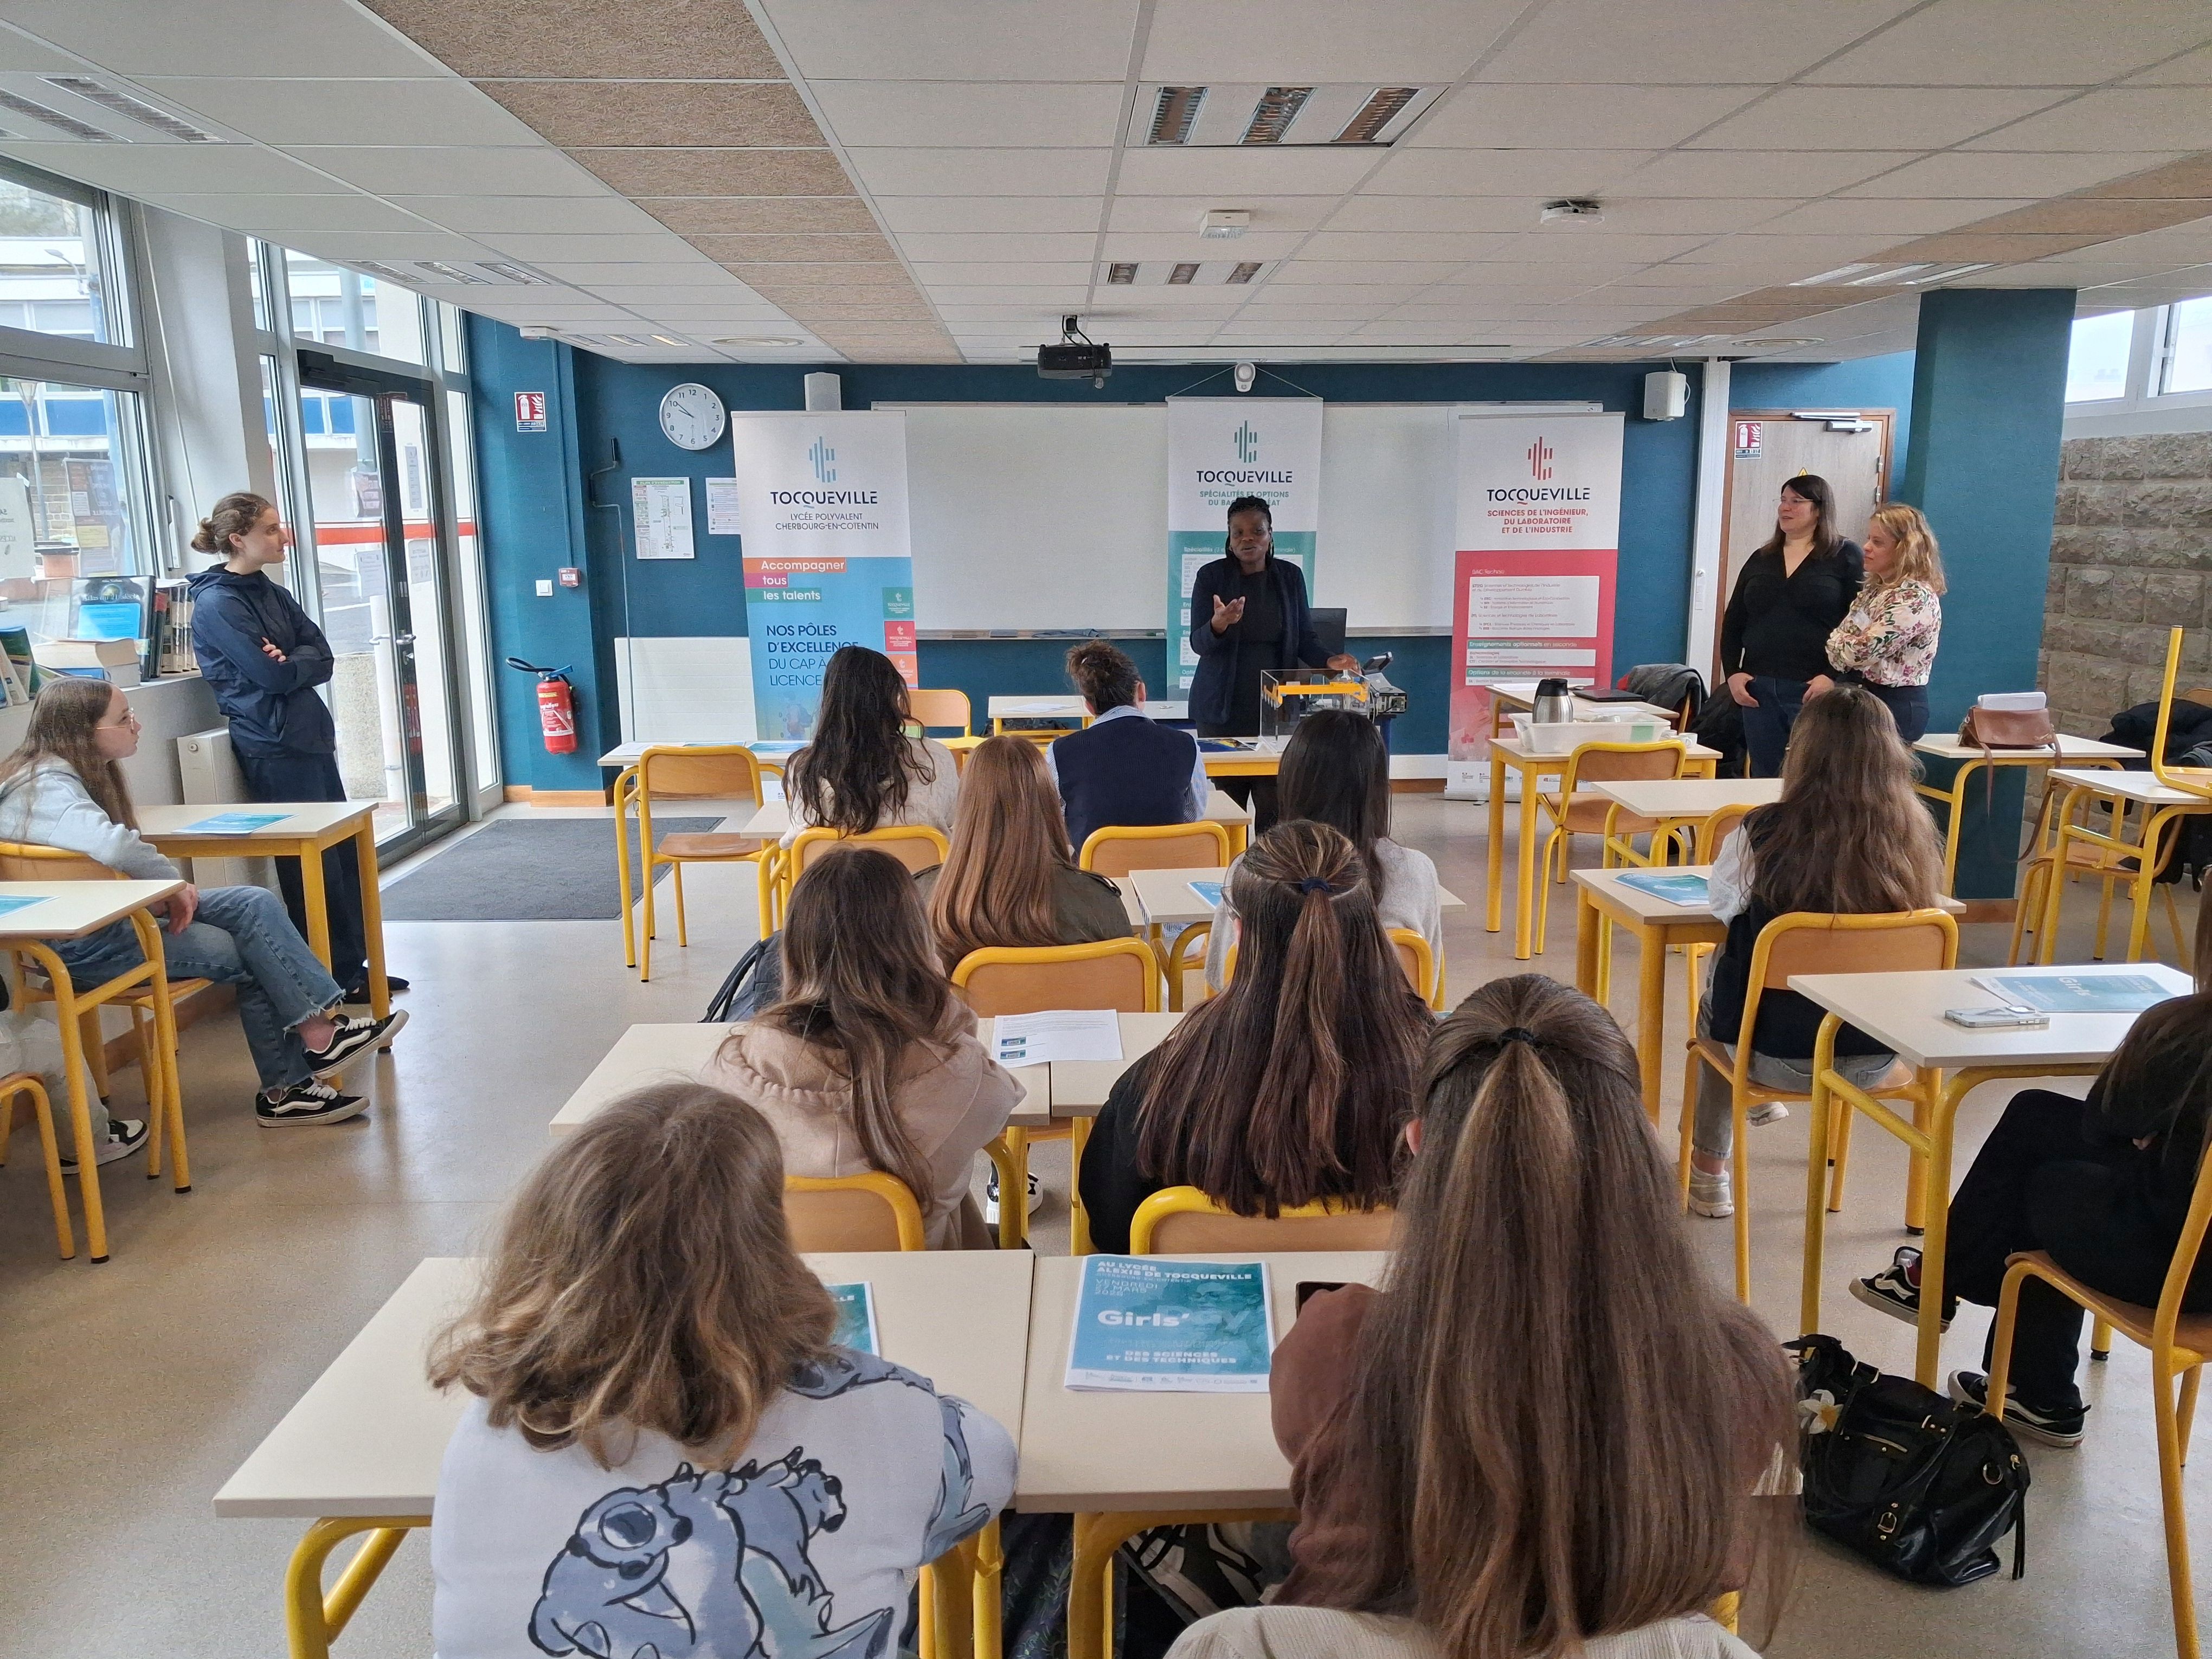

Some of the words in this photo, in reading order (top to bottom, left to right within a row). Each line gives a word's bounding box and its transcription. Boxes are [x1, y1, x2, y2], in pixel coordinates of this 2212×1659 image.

[1196, 470, 1293, 486] TOCQUEVILLE
[1199, 490, 1244, 498] SPÉCIALITÉS
[1487, 487, 1591, 505] TOCQUEVILLE
[770, 491, 878, 509] TOCQUEVILLE
[790, 511, 813, 520] LYCÉE
[1539, 507, 1589, 517] L'INGÉNIEUR,
[775, 522, 879, 530] CHERBOURG-EN-COTENTIN
[761, 561, 845, 572] Accompagner
[762, 575, 787, 586] tous
[763, 590, 779, 601] les
[782, 590, 821, 601] talents
[766, 625, 795, 636] NOS
[798, 622, 837, 636] PÔLES
[767, 641, 859, 653] D'EXCELLEN
[769, 658, 786, 670] DU
[789, 658, 816, 670] CAP
[818, 655, 827, 670] À
[770, 674, 823, 686] LICENCE
[1097, 1267, 1141, 1276] ALEXIS
[1165, 1272, 1252, 1281] TOCQUEVILLE
[1097, 1309, 1190, 1327] Girls'
[1153, 1351, 1218, 1359] SCIENCES
[1153, 1357, 1237, 1365] TECHNIQUES
